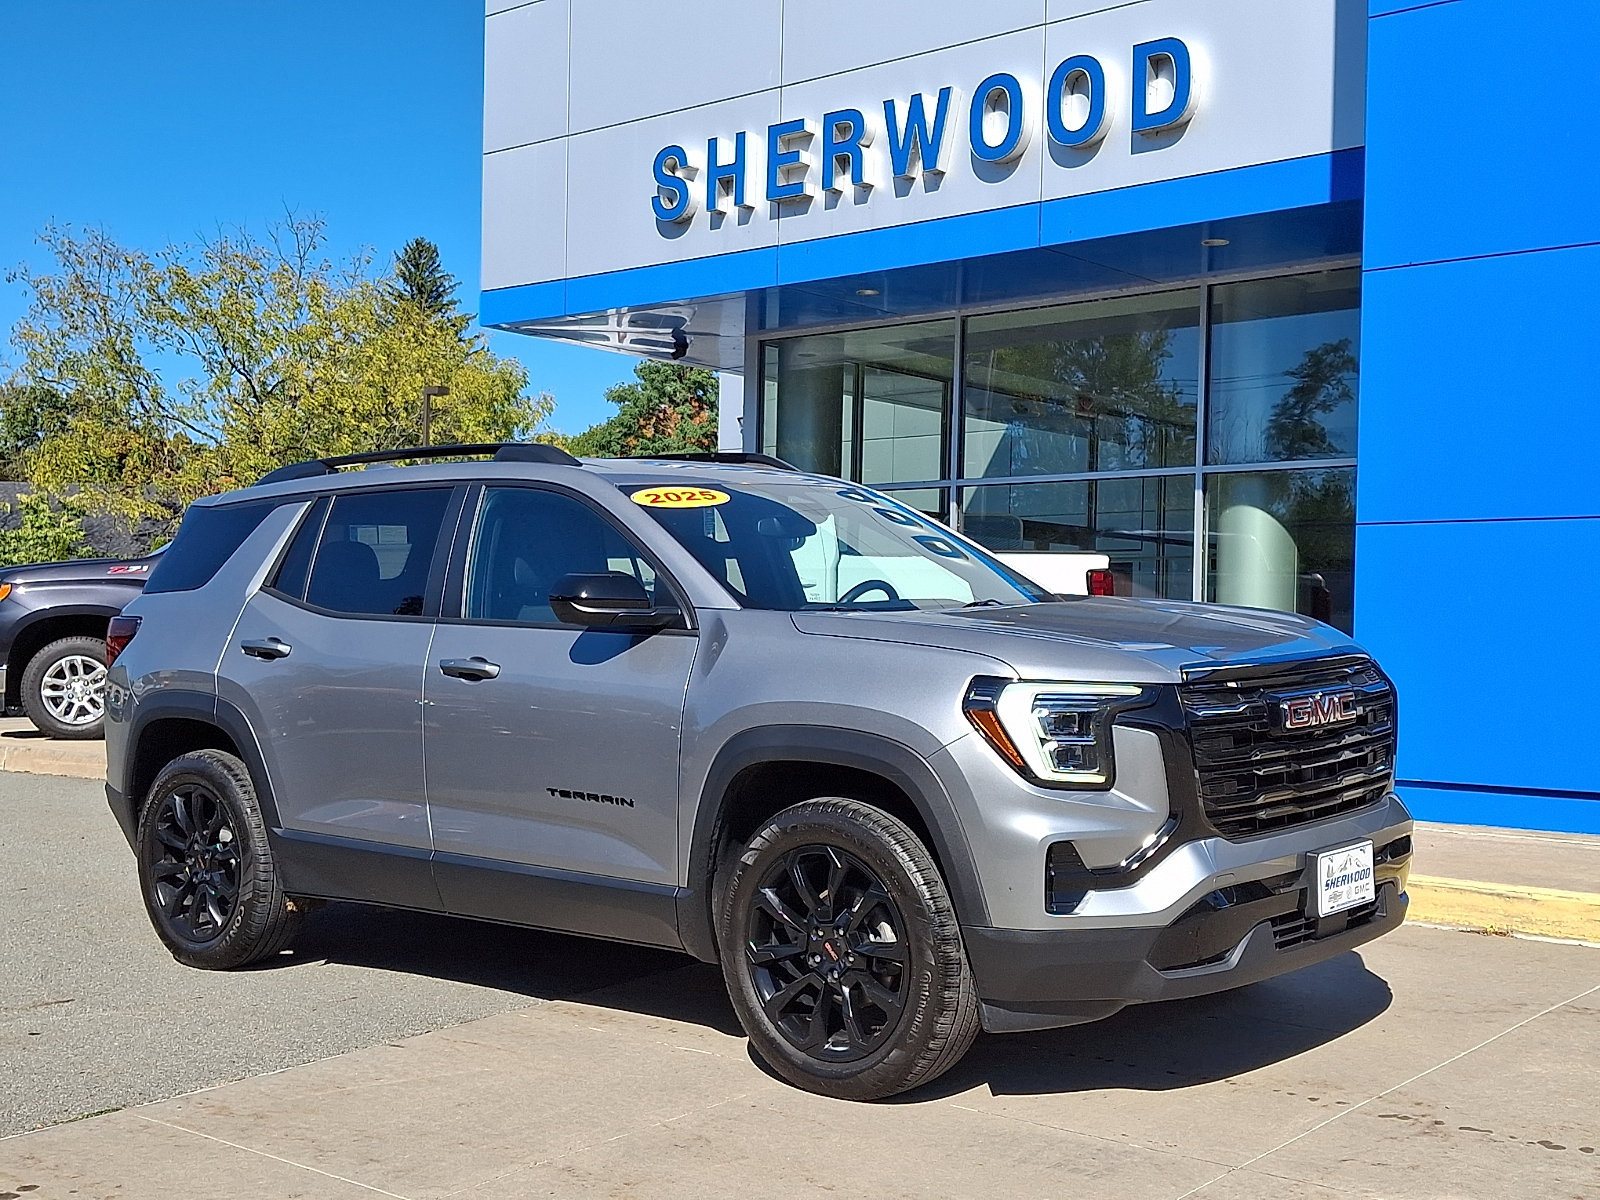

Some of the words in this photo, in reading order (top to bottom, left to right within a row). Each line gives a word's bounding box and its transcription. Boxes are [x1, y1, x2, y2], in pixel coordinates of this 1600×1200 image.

[651, 37, 1192, 223] SHERWOOD
[644, 490, 717, 504] 2025
[107, 565, 149, 575] Z71
[1281, 692, 1357, 729] GMC
[545, 787, 635, 808] TERRAIN
[1324, 867, 1371, 891] SHERWOOD
[1354, 882, 1370, 895] GMC
